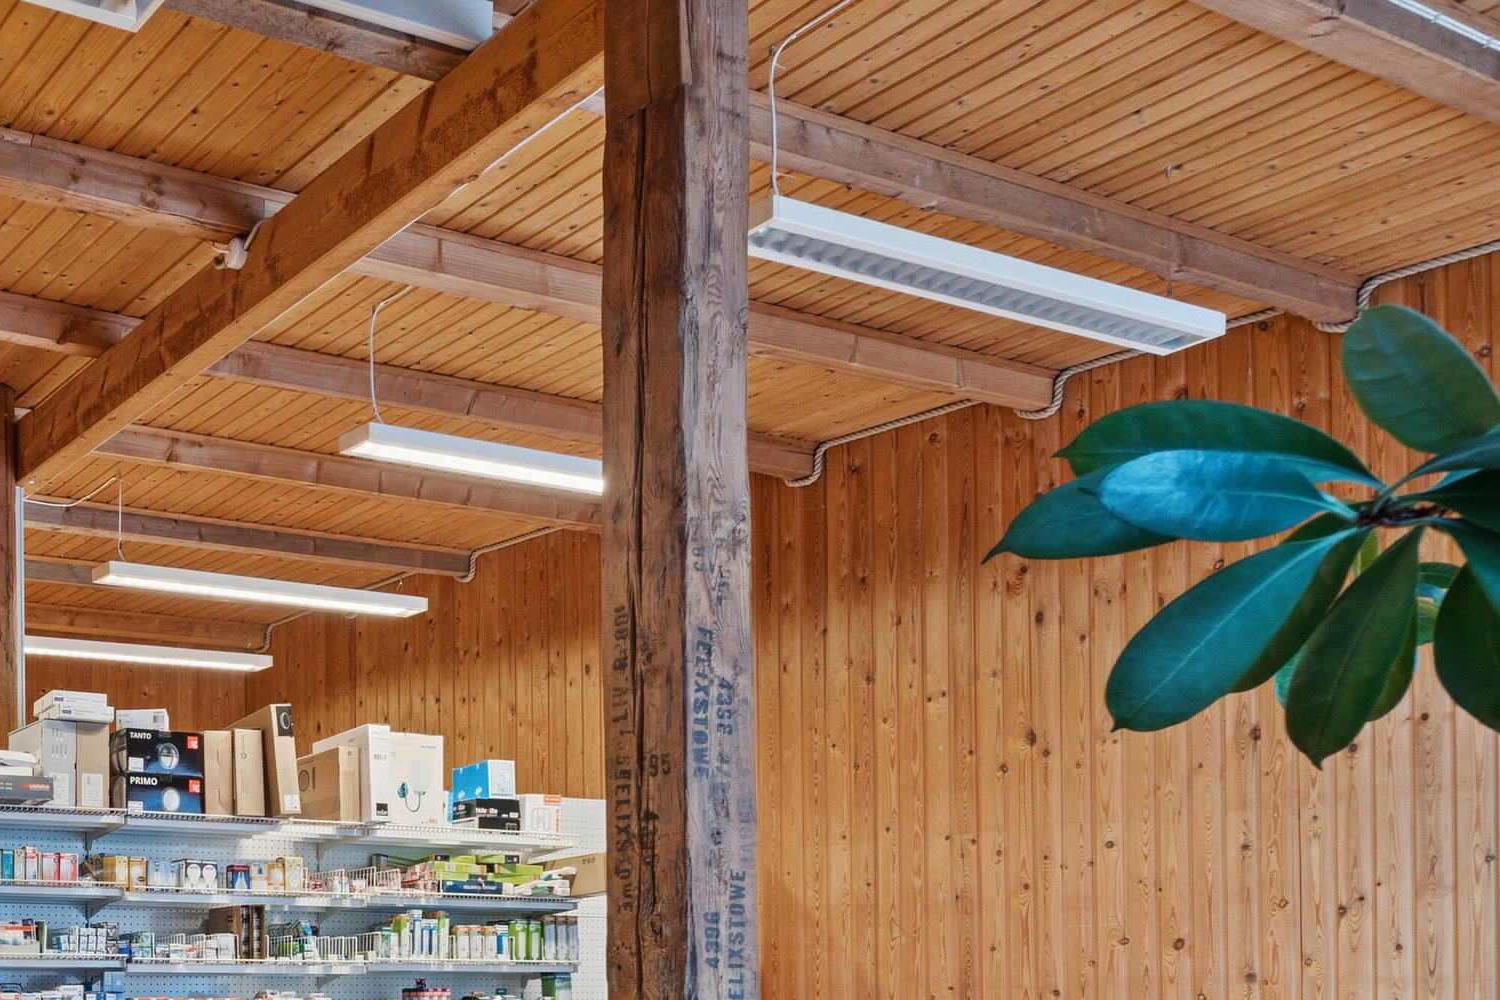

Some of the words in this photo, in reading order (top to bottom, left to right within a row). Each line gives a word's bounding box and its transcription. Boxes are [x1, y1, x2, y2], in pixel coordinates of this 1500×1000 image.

[691, 626, 714, 779] FELIXSTOWE
[129, 731, 152, 740] TANTO
[129, 776, 158, 786] PRIMO
[703, 911, 721, 969] 4396
